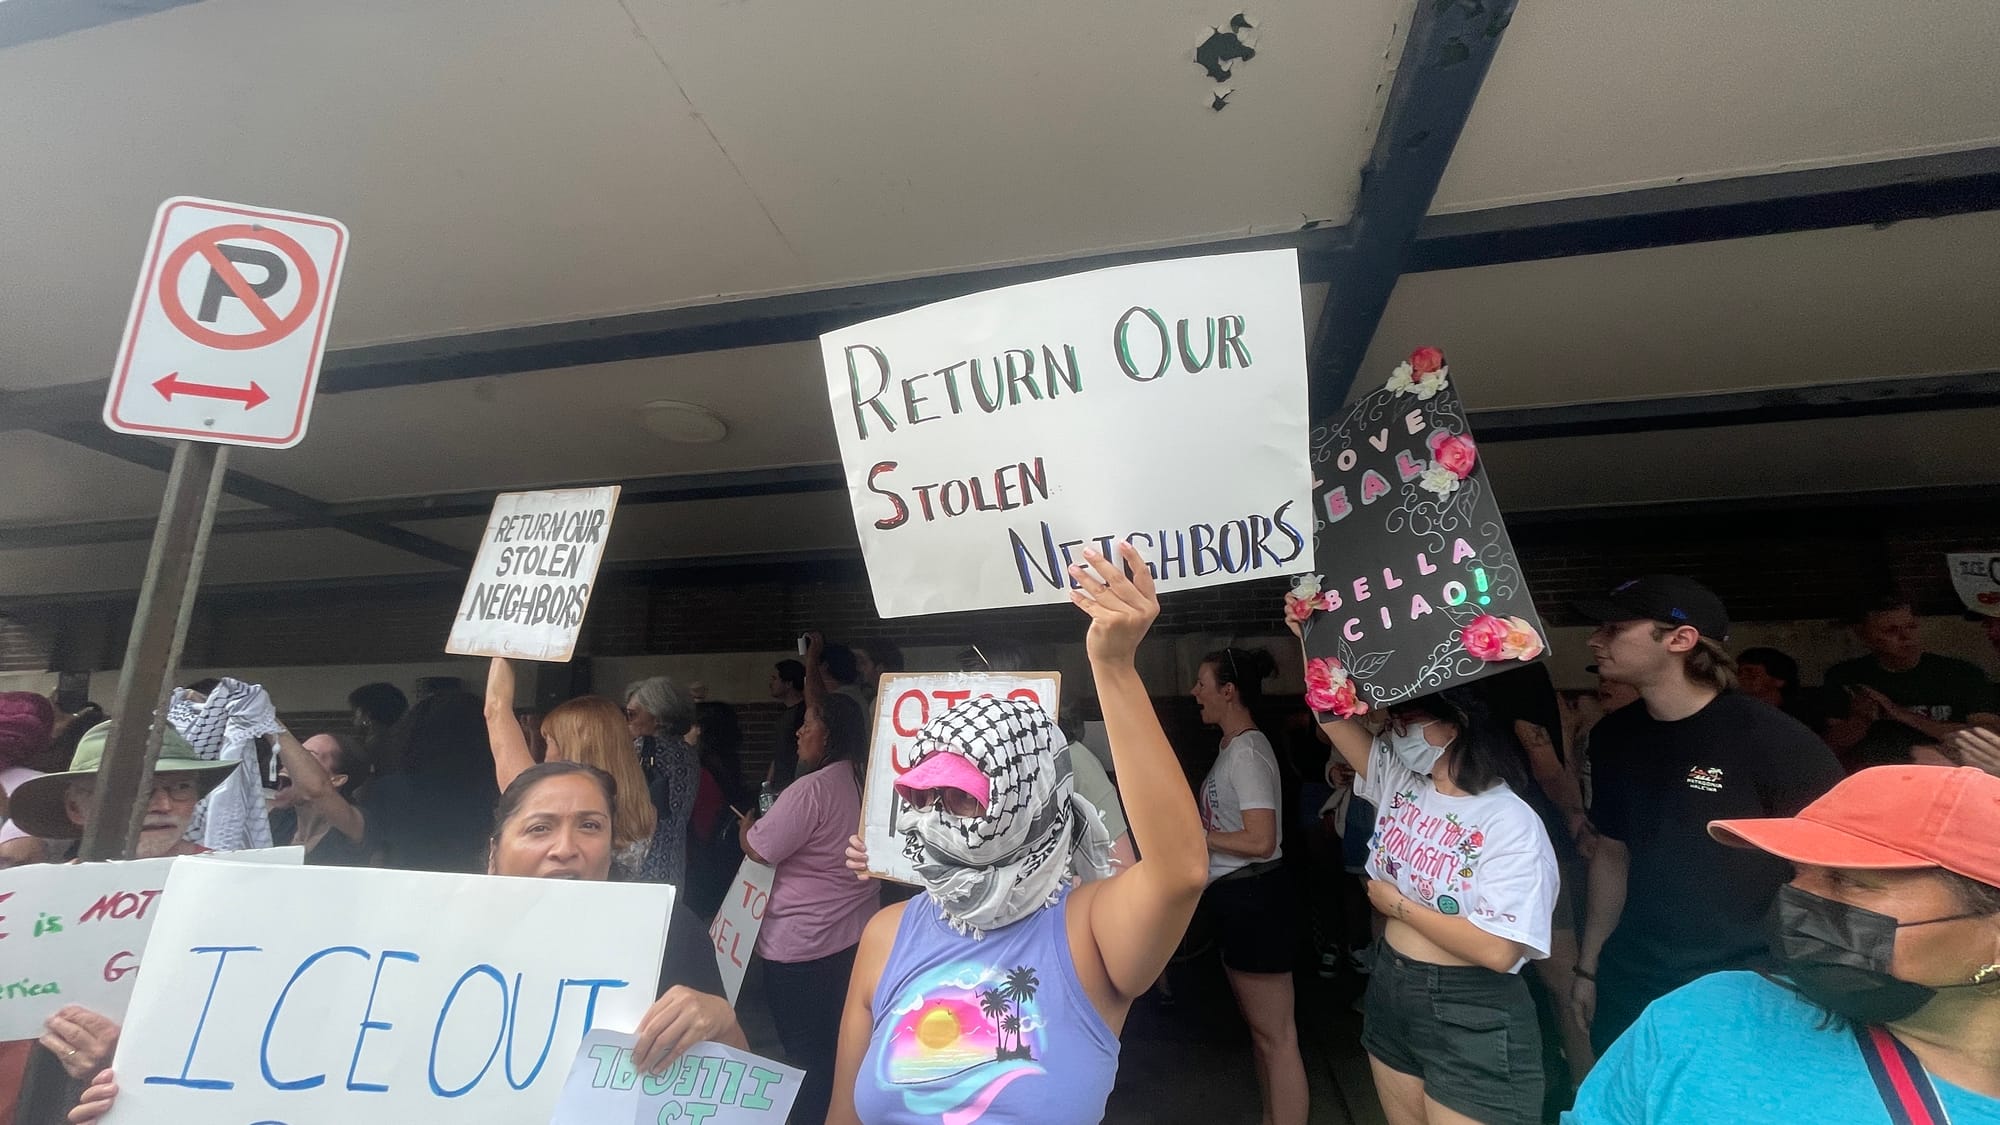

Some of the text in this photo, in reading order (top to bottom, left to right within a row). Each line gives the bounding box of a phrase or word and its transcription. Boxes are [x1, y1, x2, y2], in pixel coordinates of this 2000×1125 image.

[844, 306, 1252, 440] RETURN OUR
[867, 457, 1049, 530] STOLEN
[494, 509, 605, 544] RETURN OUR
[1008, 500, 1304, 594] NEIGHBORS
[496, 543, 585, 579] STOLEN
[1324, 538, 1475, 612] BELLA
[466, 582, 589, 630] NEIGHBORS
[33, 912, 63, 937] is
[78, 889, 164, 924] NOT
[743, 880, 768, 920] TO
[144, 946, 629, 1098] ICE OUT
